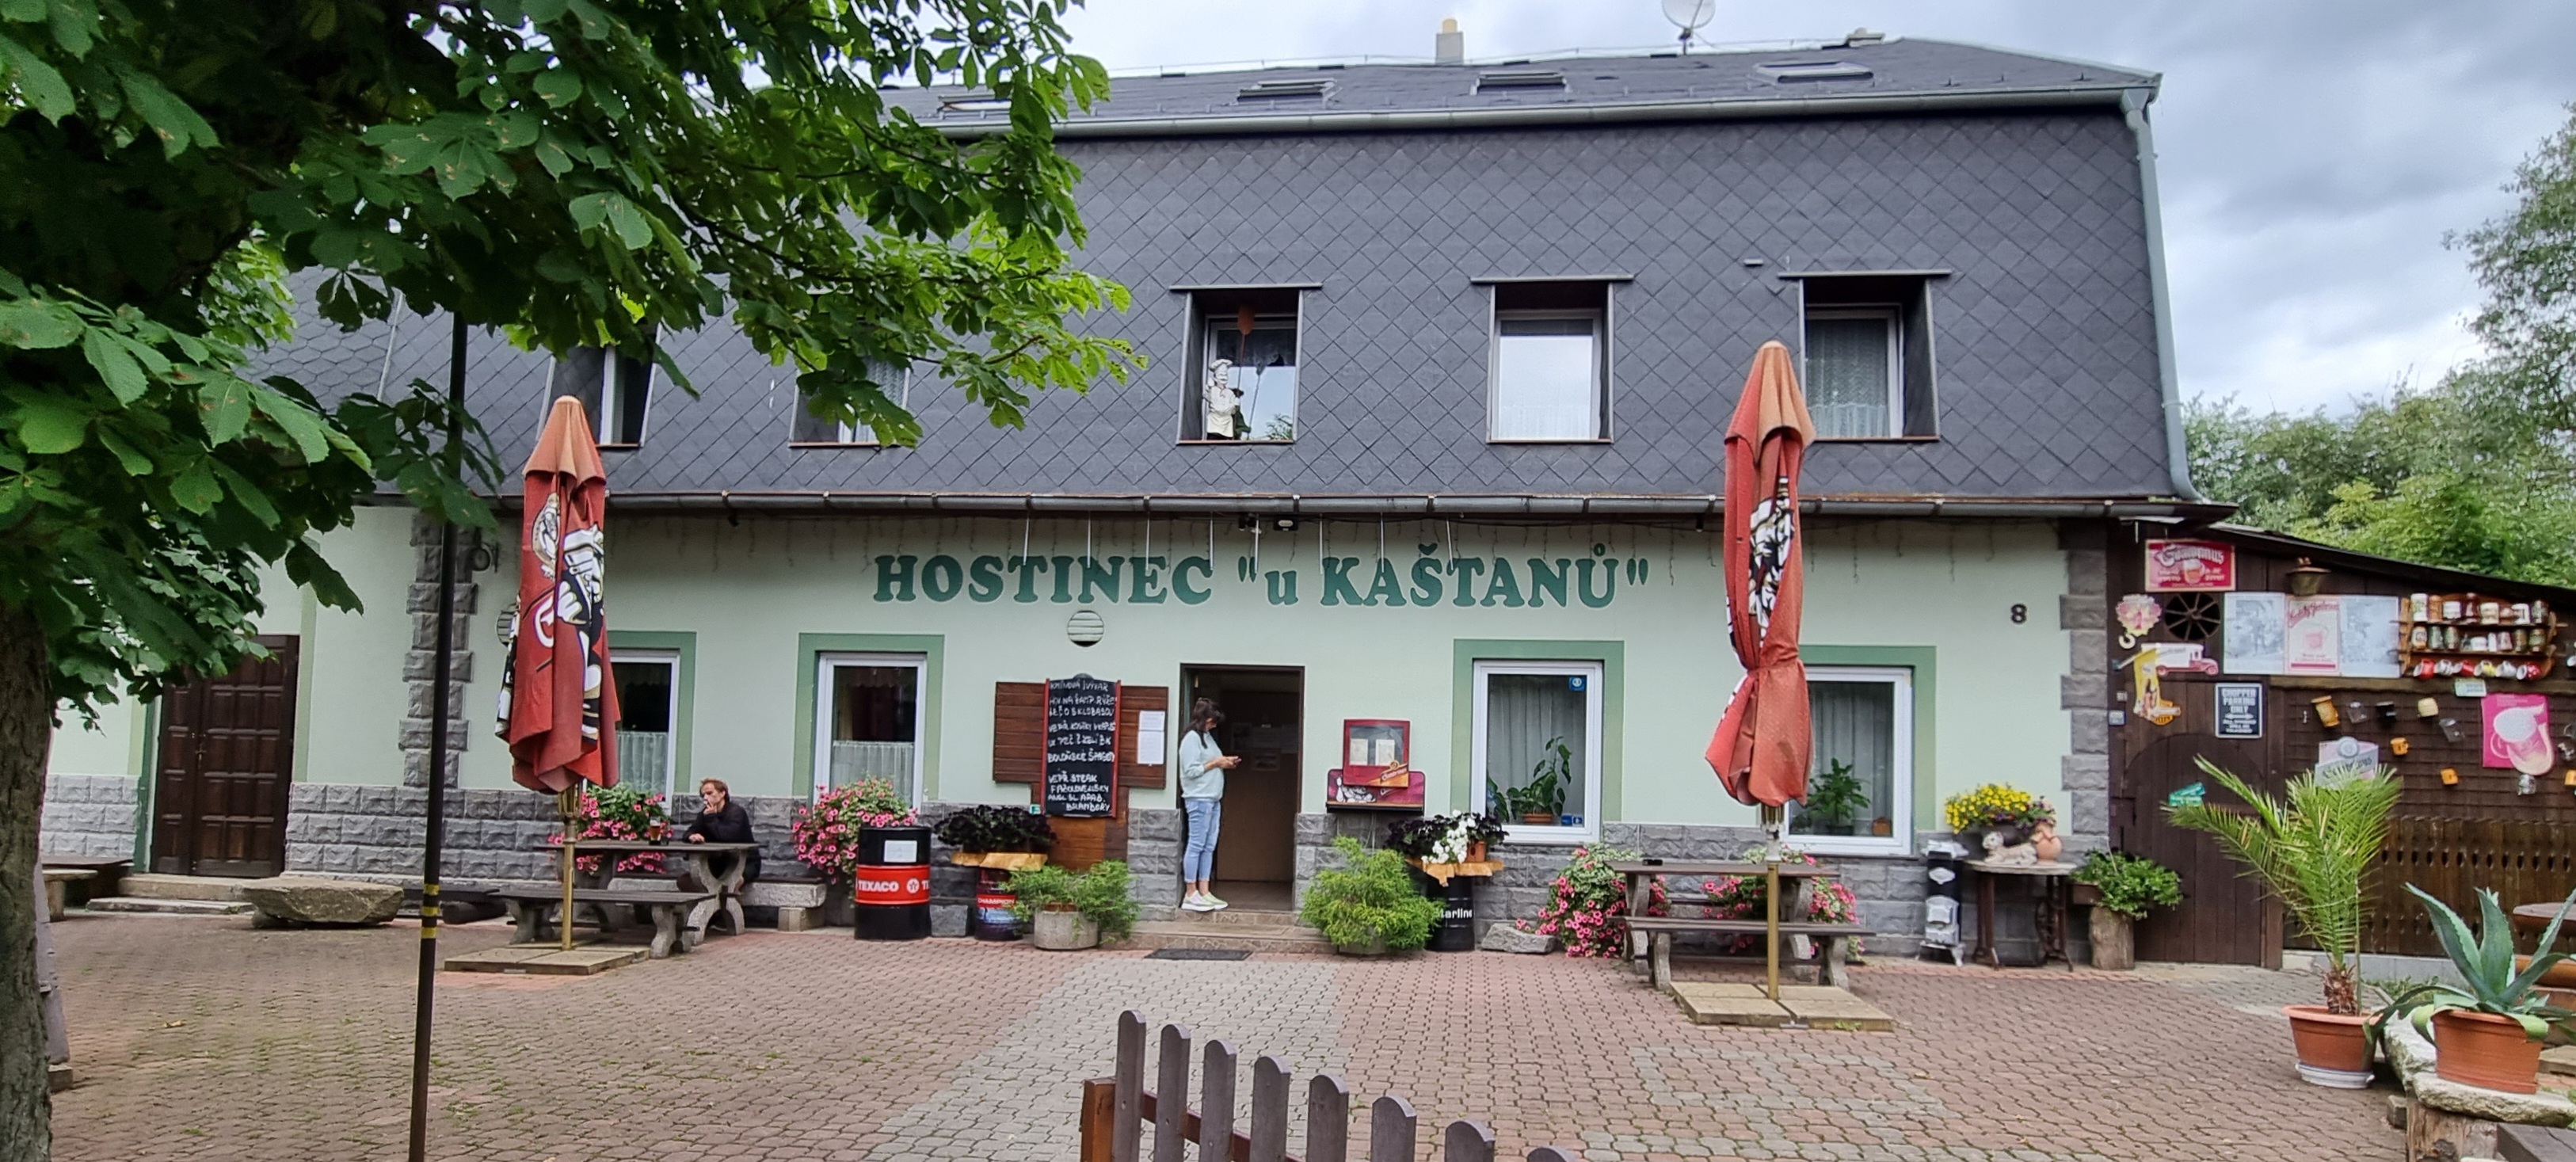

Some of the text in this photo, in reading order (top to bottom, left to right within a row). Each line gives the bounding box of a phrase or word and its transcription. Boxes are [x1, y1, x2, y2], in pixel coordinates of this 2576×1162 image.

[874, 555, 1214, 604] HOSTINEC
[1320, 543, 1649, 608] KAŠTANŮ"
[2011, 604, 2027, 624] 8
[858, 879, 899, 893] TEXACO
